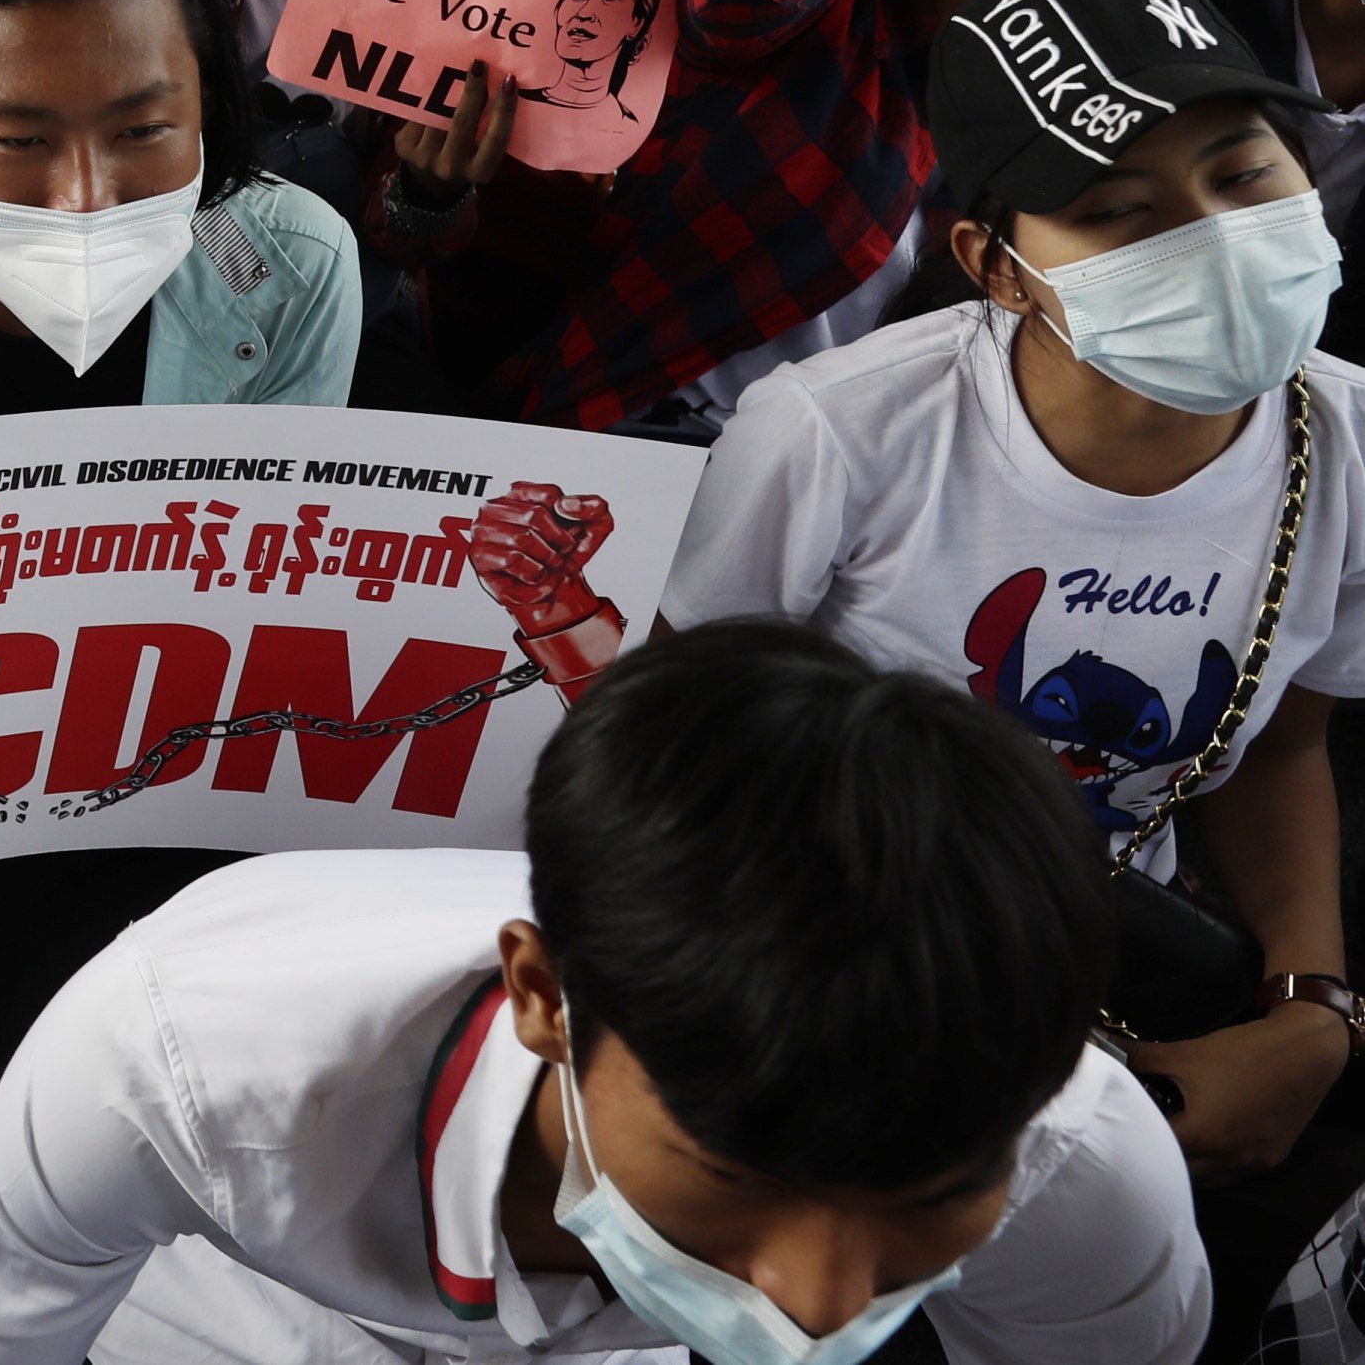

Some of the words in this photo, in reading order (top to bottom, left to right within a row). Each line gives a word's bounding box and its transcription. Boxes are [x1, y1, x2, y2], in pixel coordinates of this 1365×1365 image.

[75, 458, 299, 487] DISOBEDIENCE
[302, 459, 493, 500] MOVEMENT
[242, 502, 474, 603] ရုန်းထွက်
[1057, 566, 1224, 620] Hello!
